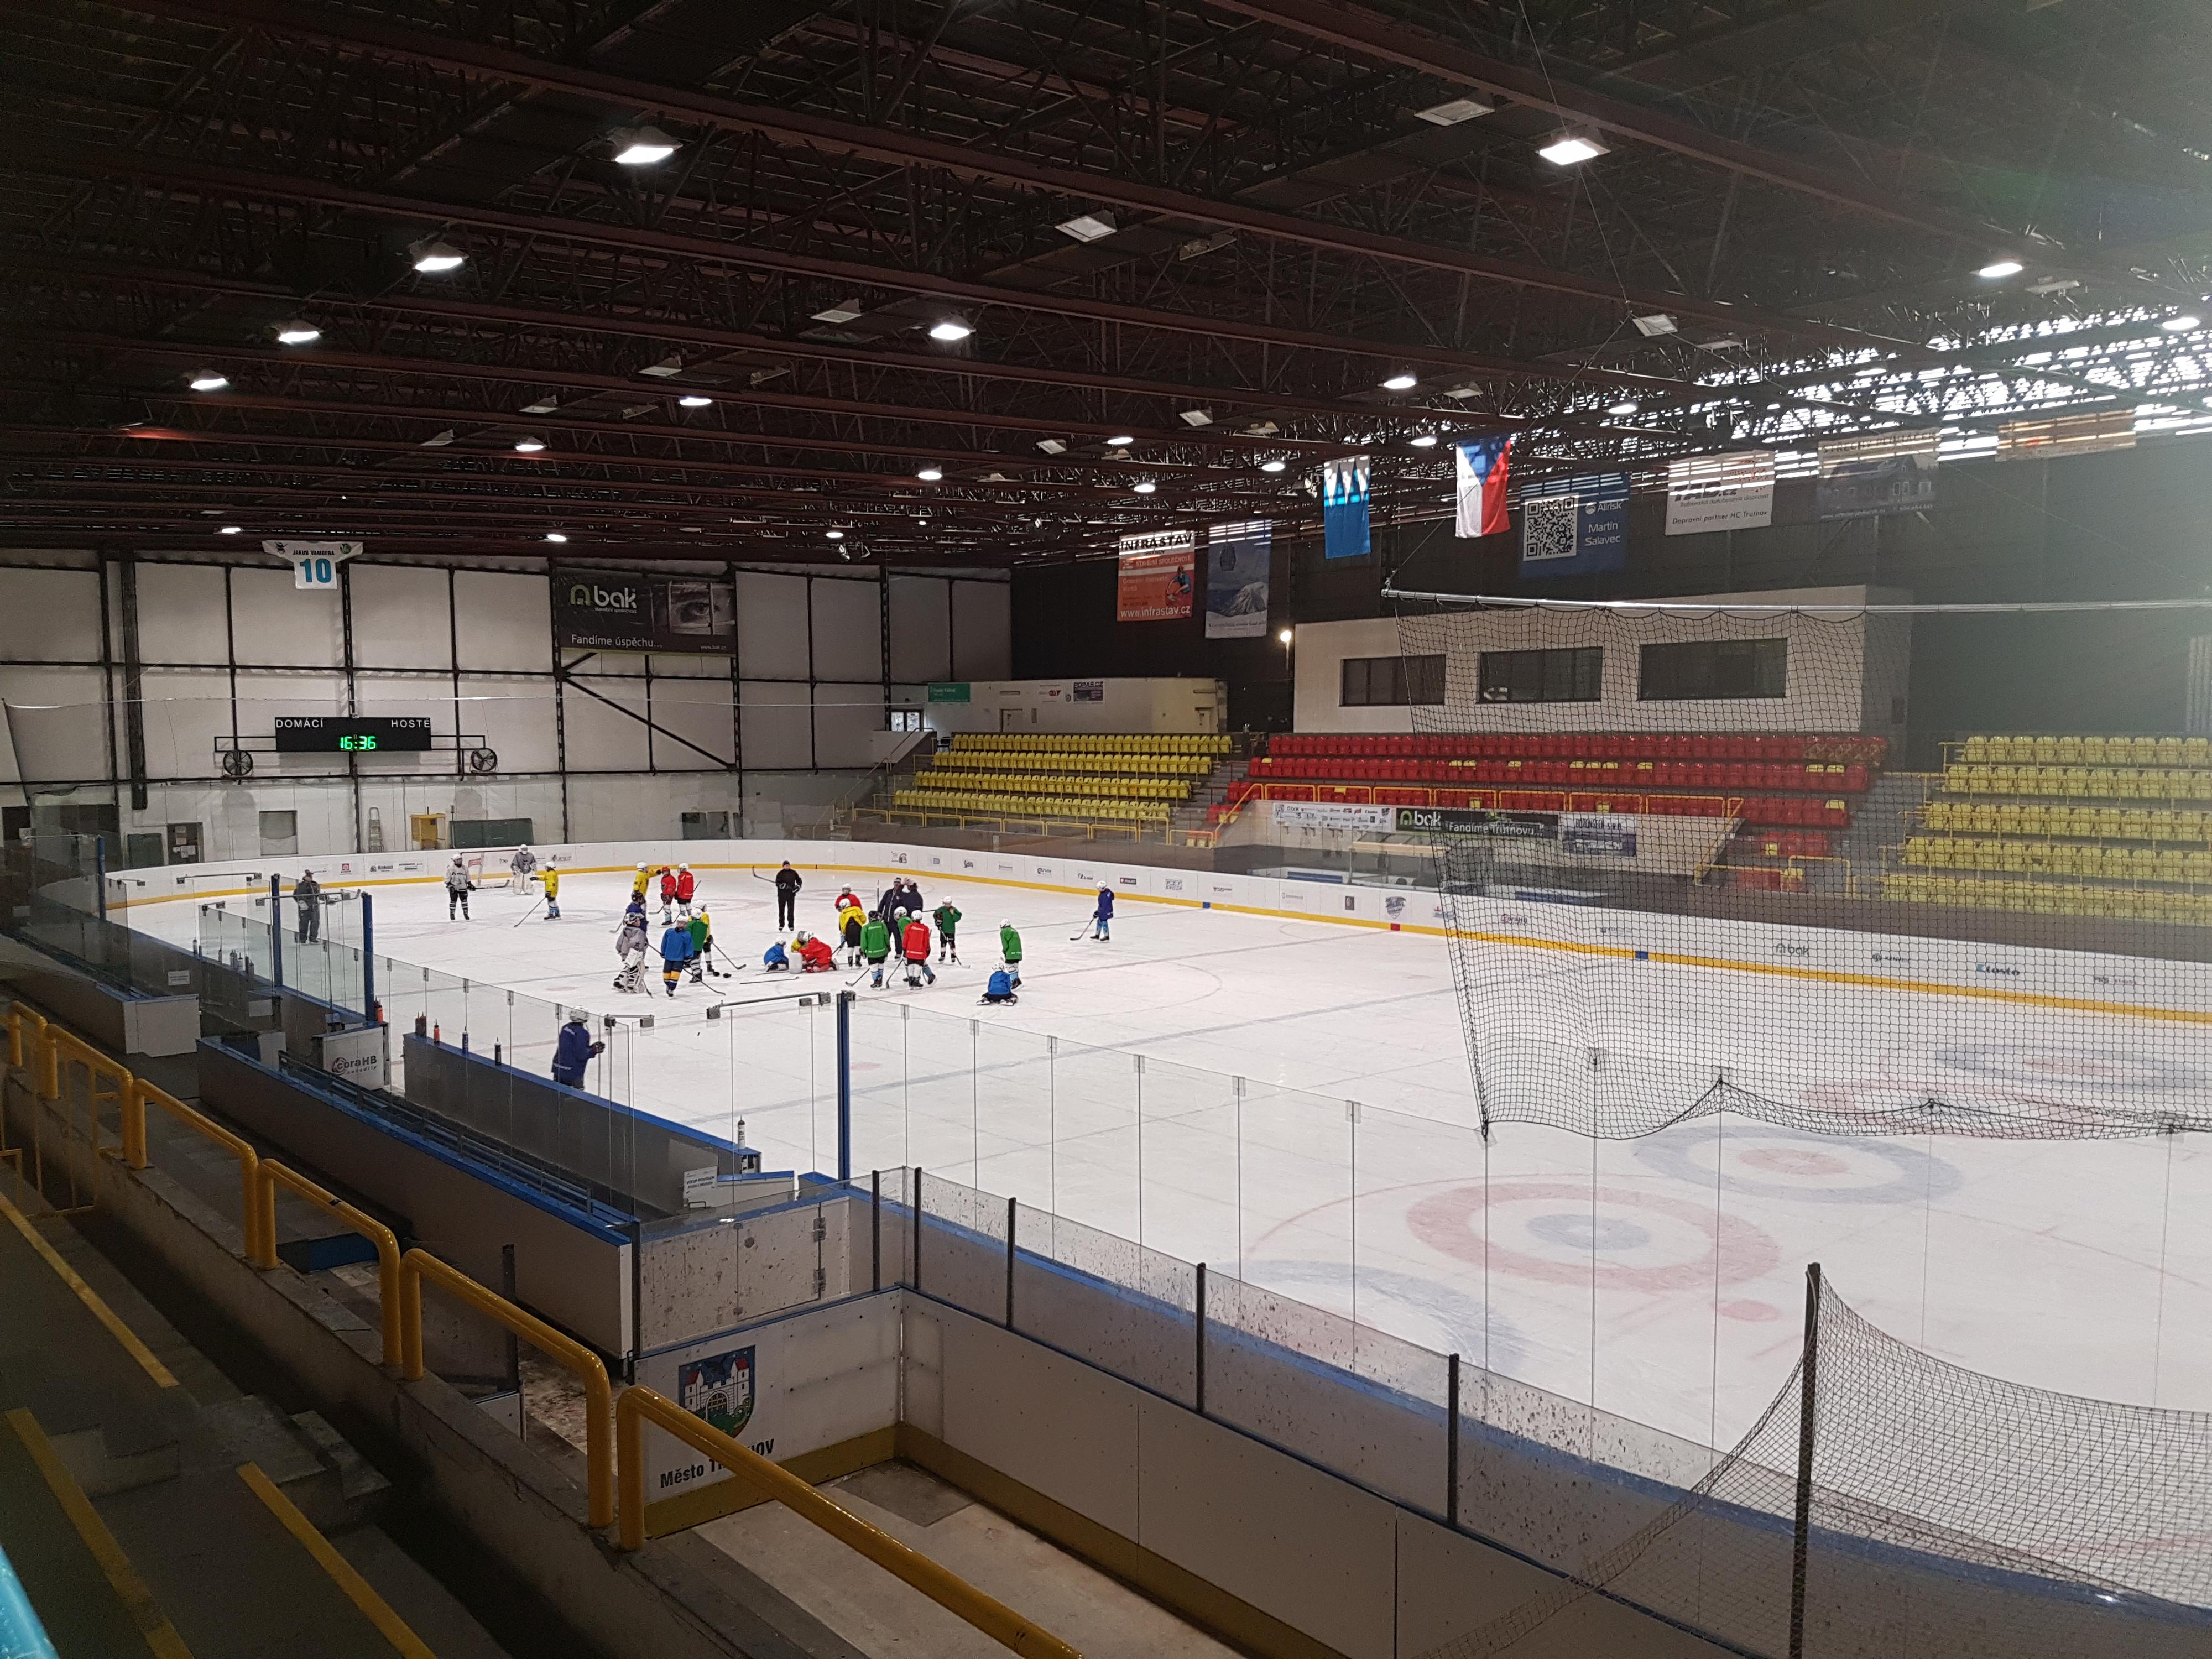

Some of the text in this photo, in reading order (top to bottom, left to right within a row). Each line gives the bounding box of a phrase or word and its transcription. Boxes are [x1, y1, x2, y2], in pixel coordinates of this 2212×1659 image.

[1597, 502, 1621, 512] Allrisk
[1588, 521, 1618, 533] Martin
[1121, 534, 1193, 551] INFRASTAV
[1585, 535, 1621, 546] Salavec
[300, 558, 332, 583] 10
[593, 585, 637, 609] bak
[1120, 605, 1191, 618] www.infrastav.cz
[571, 634, 662, 648] Fandíme úspěchu...
[276, 717, 430, 728] DOMÁCÍ HOSTÉ
[340, 736, 376, 749] 16:36
[1414, 810, 1441, 827] bak
[1449, 822, 1488, 833] Fandíme
[1787, 943, 1809, 956] bak
[660, 1464, 705, 1489] Město
